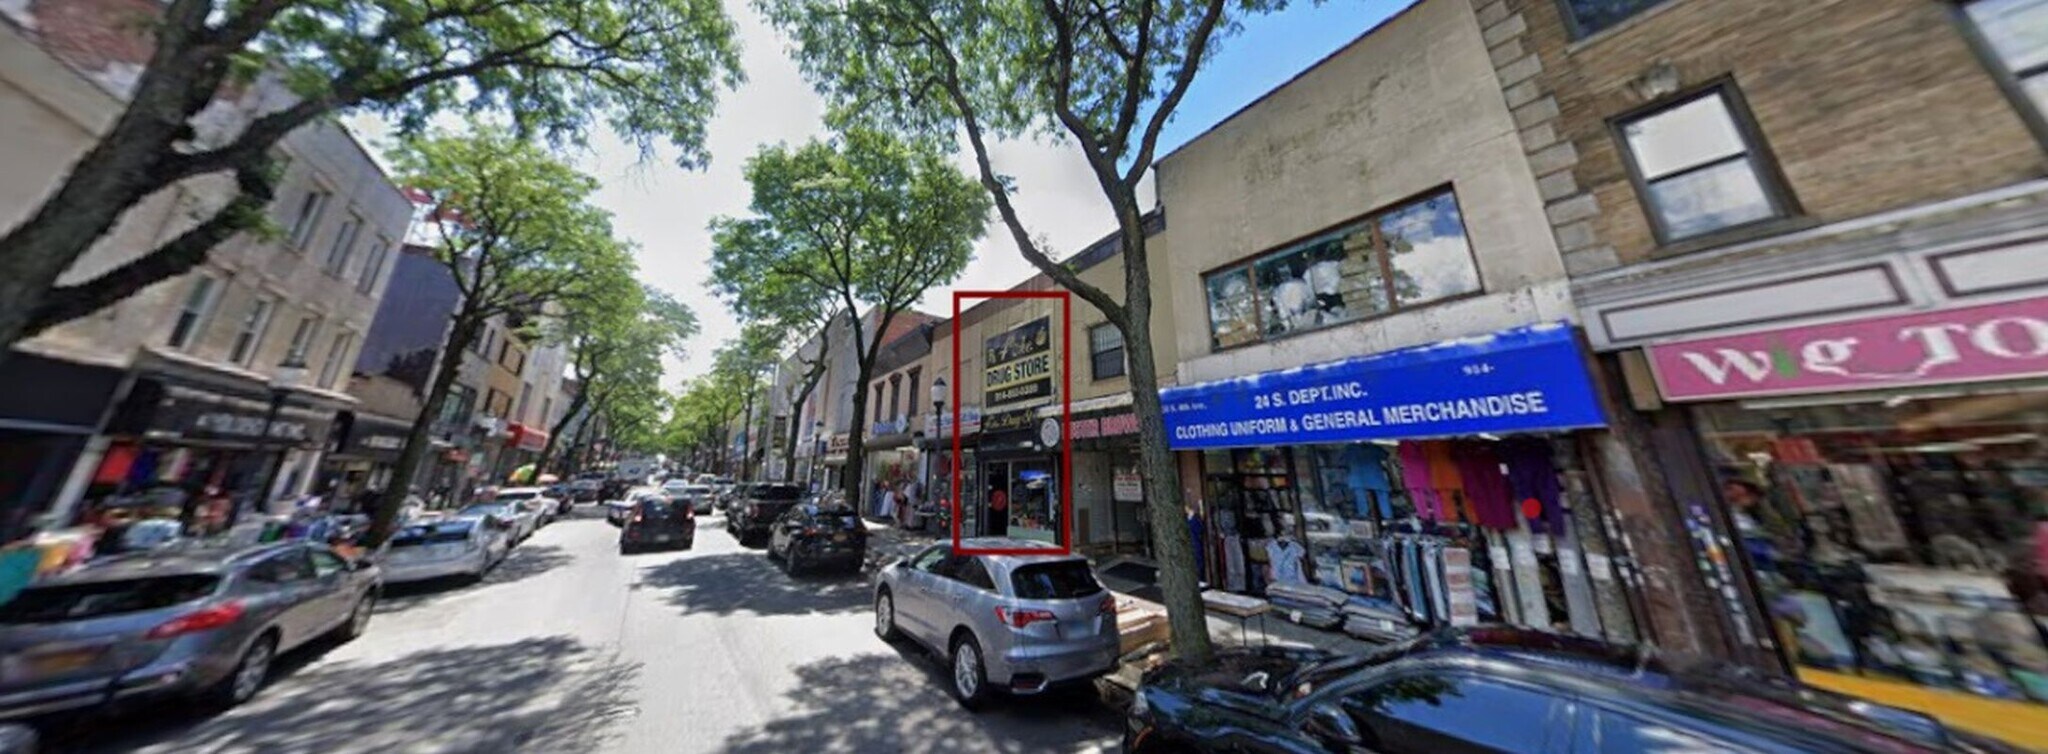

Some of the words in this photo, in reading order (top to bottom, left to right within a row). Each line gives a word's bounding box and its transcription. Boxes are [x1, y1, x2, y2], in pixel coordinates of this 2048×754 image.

[986, 365, 1012, 387] DRUG
[1014, 354, 1049, 380] STORE
[1175, 423, 1228, 440] CLOTHING
[1230, 417, 1287, 436] UNIFORM
[1289, 418, 1299, 433] &
[1302, 409, 1381, 431] GENERAL
[1383, 391, 1548, 425] MERCHANDISE
[1271, 394, 1286, 408] S.
